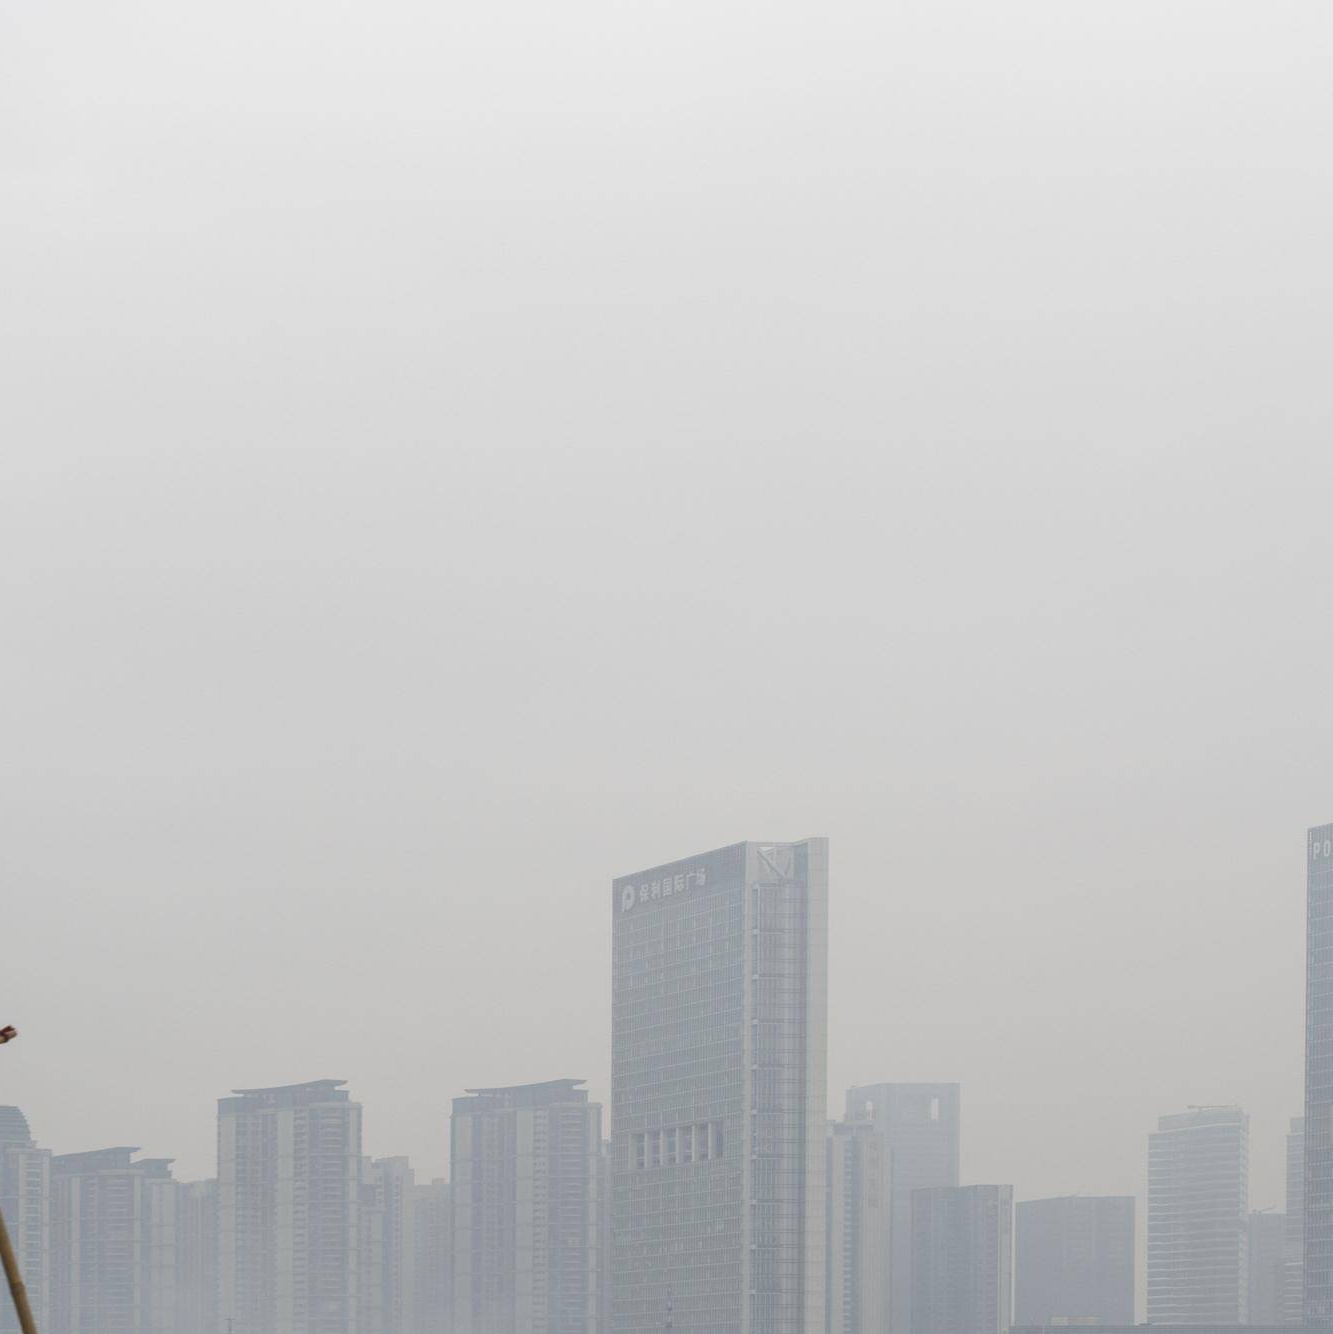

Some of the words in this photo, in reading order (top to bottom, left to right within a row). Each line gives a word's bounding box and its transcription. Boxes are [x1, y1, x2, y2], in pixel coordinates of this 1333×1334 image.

[640, 867, 706, 904] 保利国际广场
